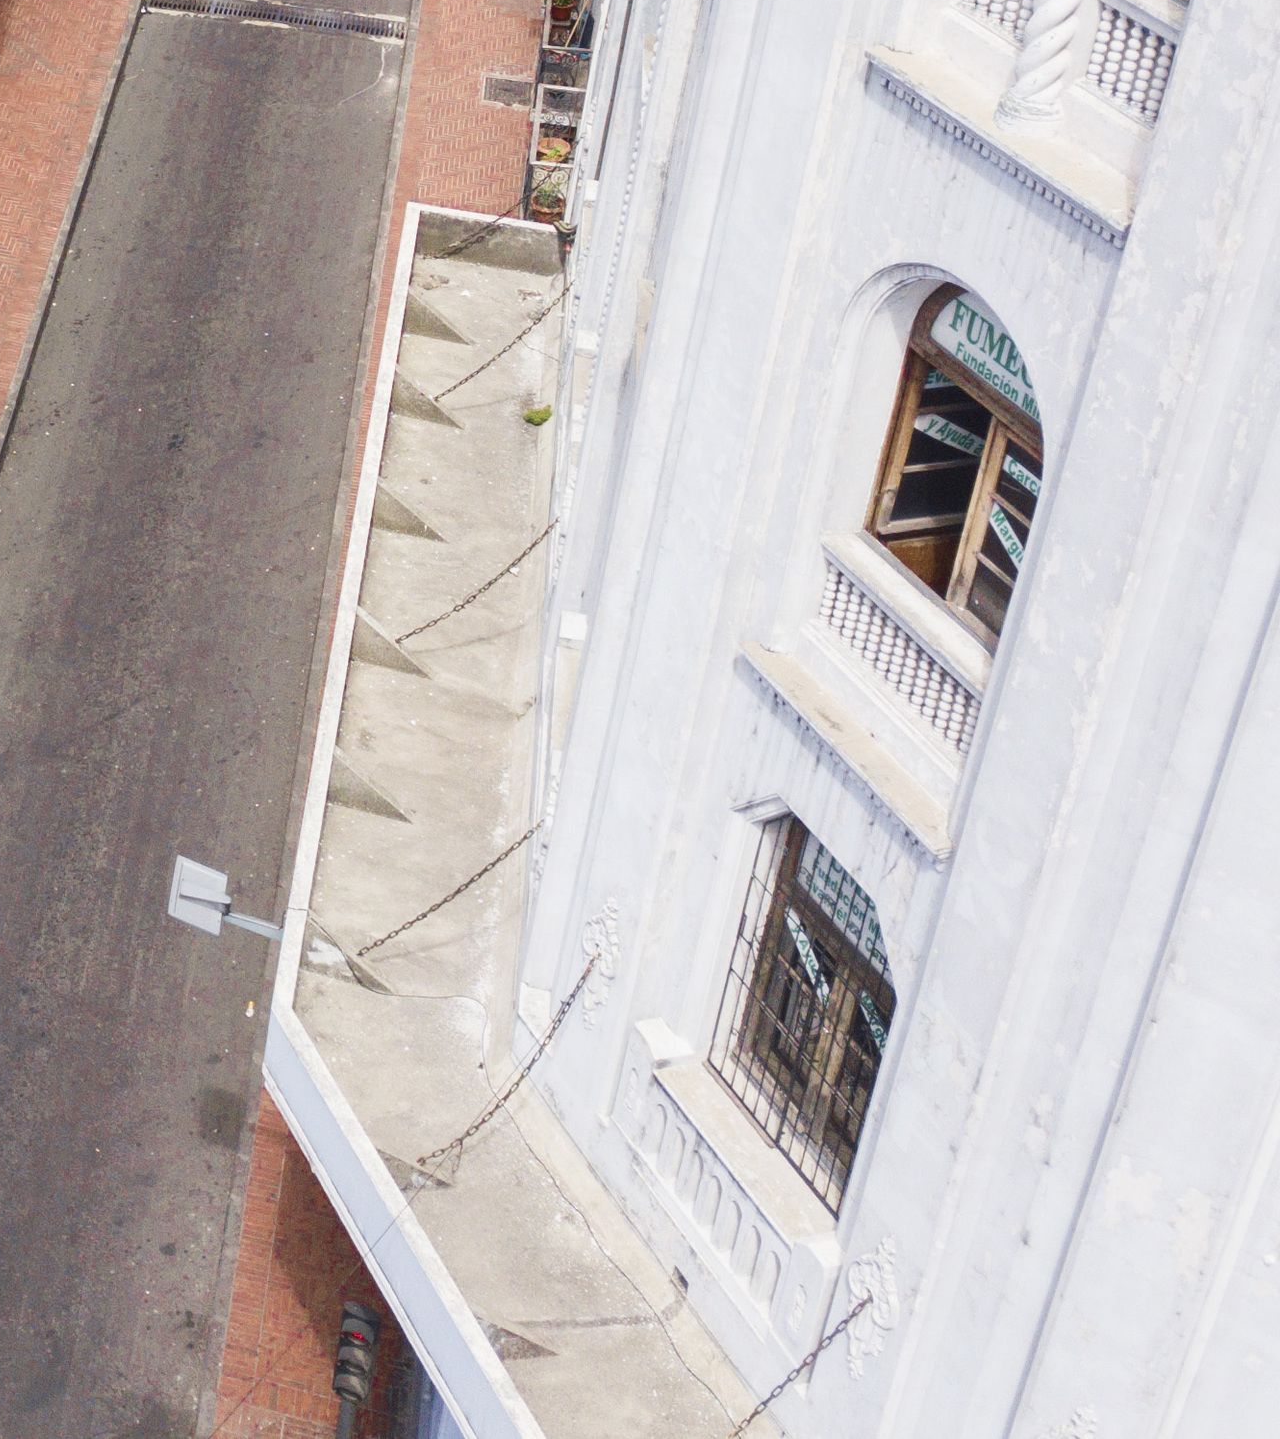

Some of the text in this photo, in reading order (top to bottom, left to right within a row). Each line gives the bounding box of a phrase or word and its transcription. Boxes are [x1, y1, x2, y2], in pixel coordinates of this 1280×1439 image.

[955, 340, 1020, 402] Fundación
[923, 418, 938, 433] y
[936, 421, 976, 451] Ayuda
